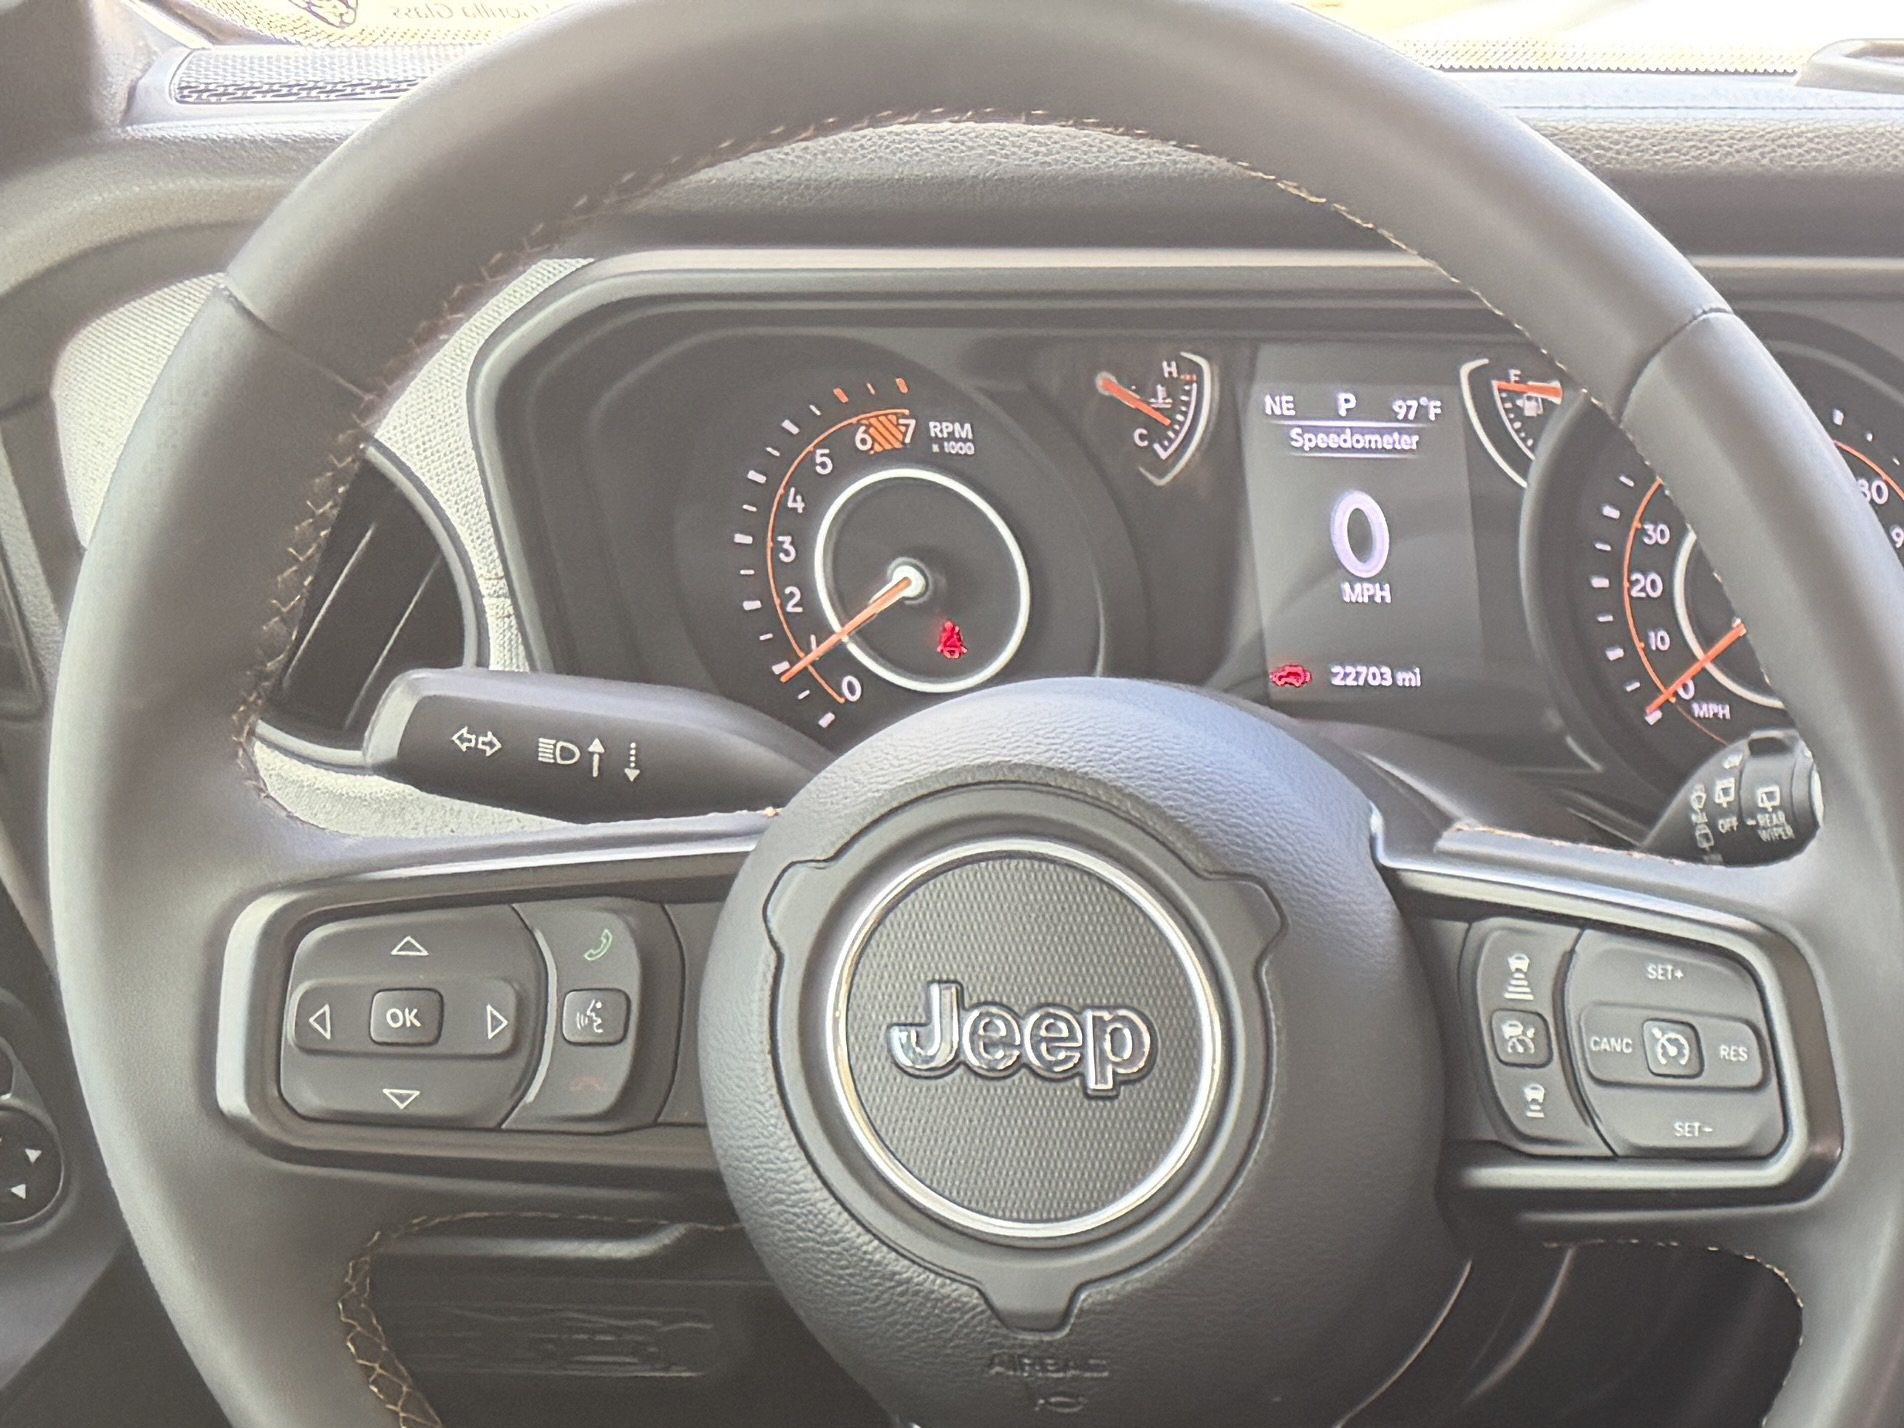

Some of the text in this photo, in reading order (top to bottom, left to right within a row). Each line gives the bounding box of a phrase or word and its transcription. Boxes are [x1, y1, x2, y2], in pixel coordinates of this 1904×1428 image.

[1162, 360, 1178, 378] H
[1264, 394, 1296, 416] NE
[1337, 392, 1357, 417] P
[855, 425, 873, 451] 6
[899, 419, 916, 444] 7
[929, 421, 973, 440] RPM
[1133, 428, 1149, 447] C
[1289, 427, 1420, 451] Speedometer
[943, 442, 975, 455] 1000
[815, 448, 833, 475] 5
[787, 487, 805, 513] 4
[1330, 489, 1390, 578] 0
[1642, 523, 1670, 545] 30
[777, 536, 797, 563] 3
[1341, 582, 1392, 604] MPH
[1630, 572, 1663, 598] 20
[784, 586, 803, 613] 2
[1648, 630, 1670, 651] 10
[1330, 665, 1421, 687] 22703 mi
[842, 675, 862, 702] 0
[1691, 702, 1731, 721] MPH
[1757, 811, 1786, 828] REAR
[1758, 825, 1796, 842] WIPER
[386, 1007, 422, 1031] OK
[890, 980, 1155, 1094] Jeep
[1590, 1035, 1633, 1054] CANC
[1719, 1043, 1749, 1062] RES
